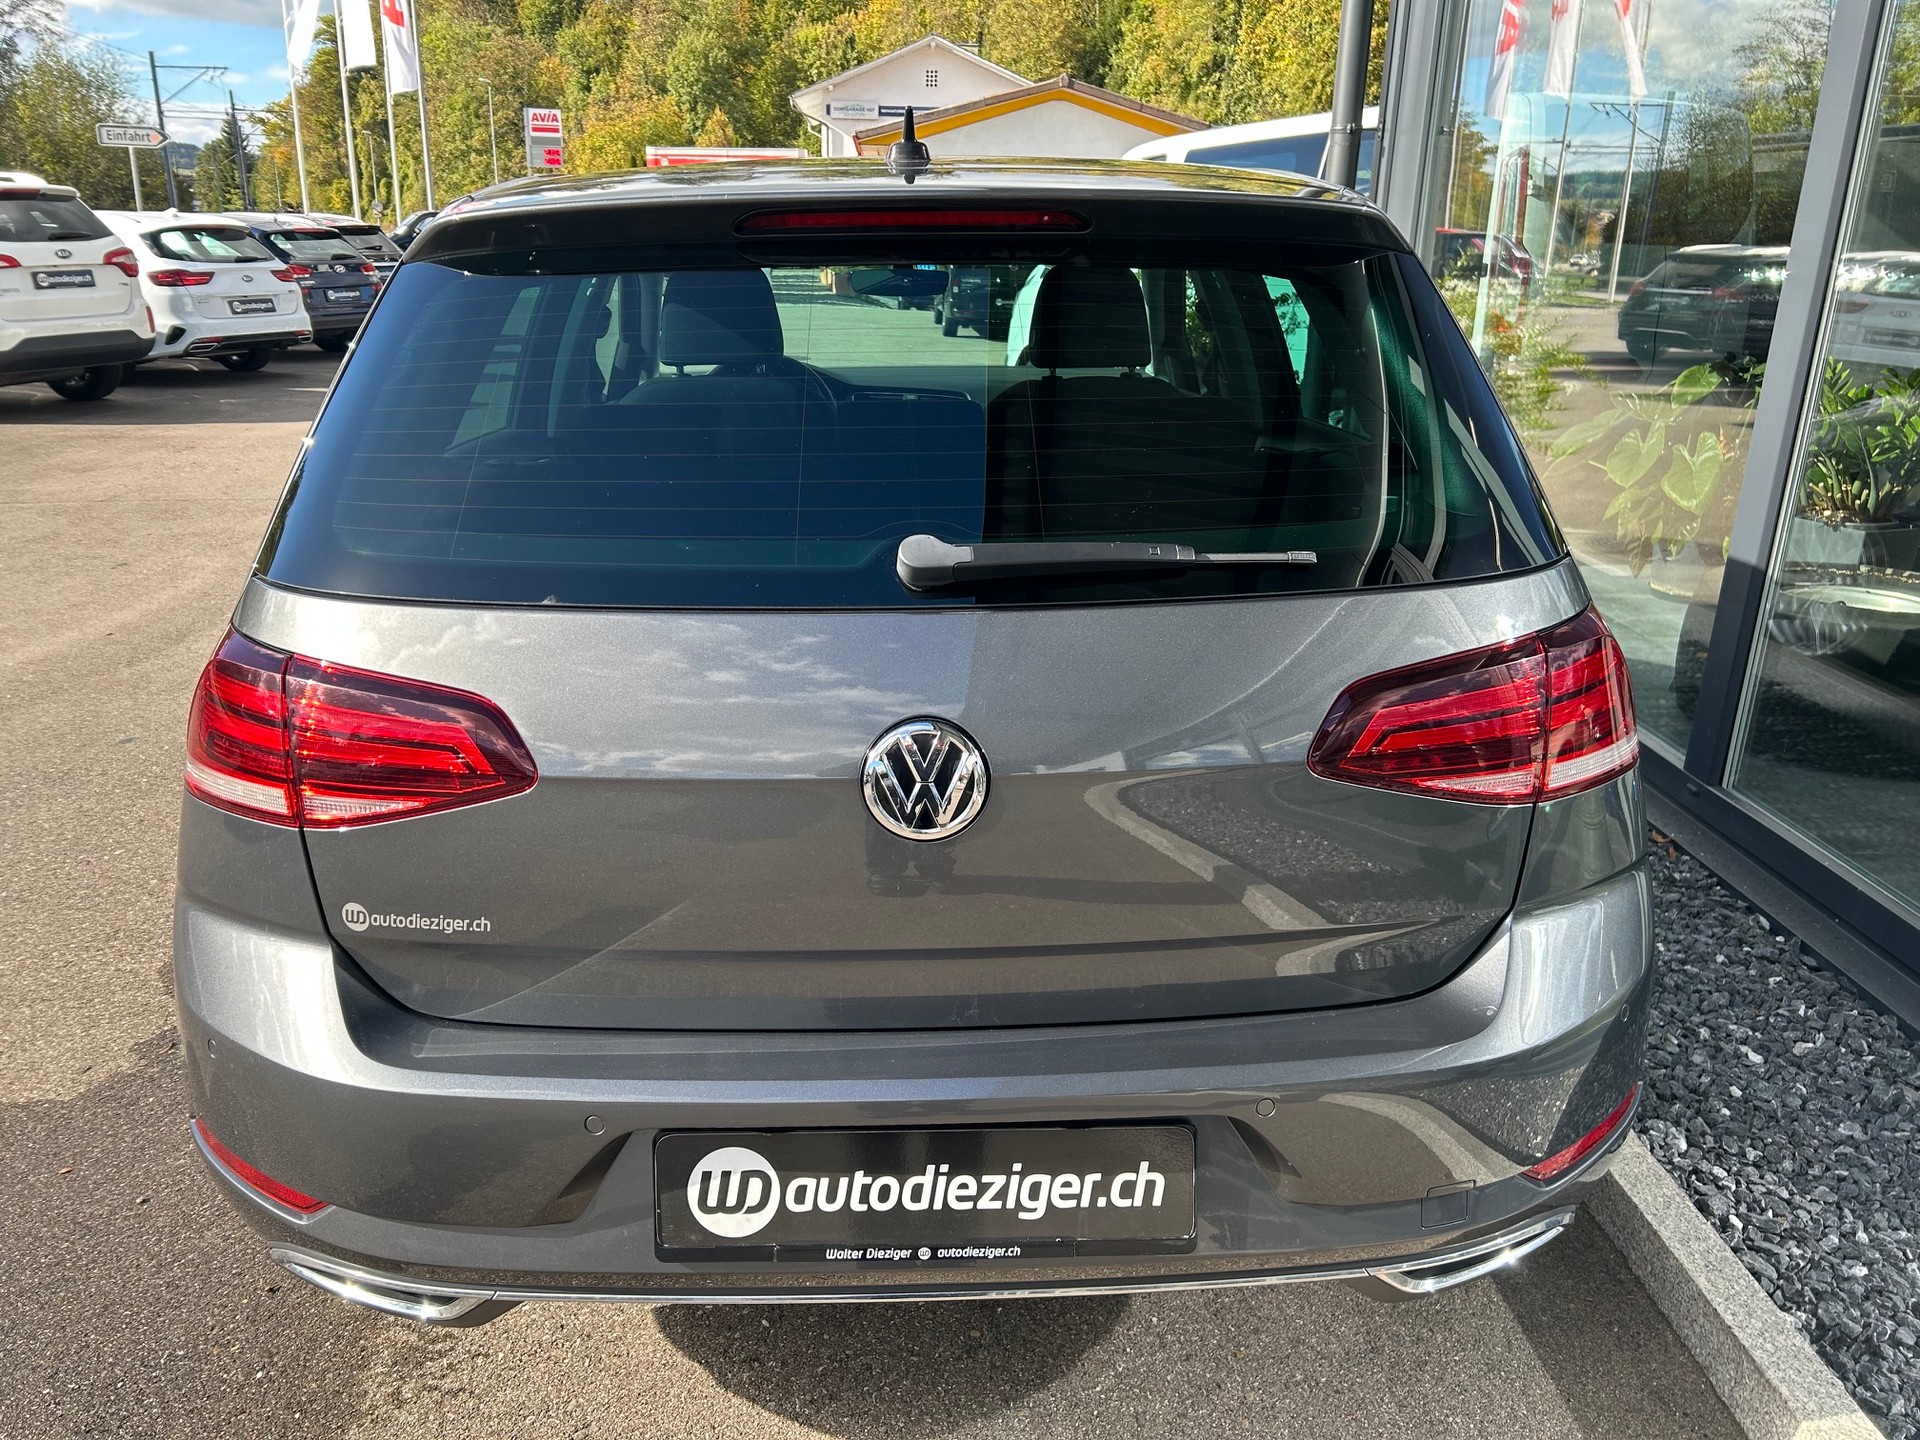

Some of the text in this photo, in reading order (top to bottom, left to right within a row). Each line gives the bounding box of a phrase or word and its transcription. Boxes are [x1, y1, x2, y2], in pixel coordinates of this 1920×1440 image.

[531, 111, 559, 123] AVIA
[106, 129, 152, 143] Einfahrt
[370, 913, 491, 934] autodieziger.ch
[784, 1160, 1166, 1221] autodieziger.ch
[825, 1248, 863, 1260] Walter
[866, 1248, 912, 1261] Dieziger
[937, 1246, 1021, 1259] autodieziger.ch
